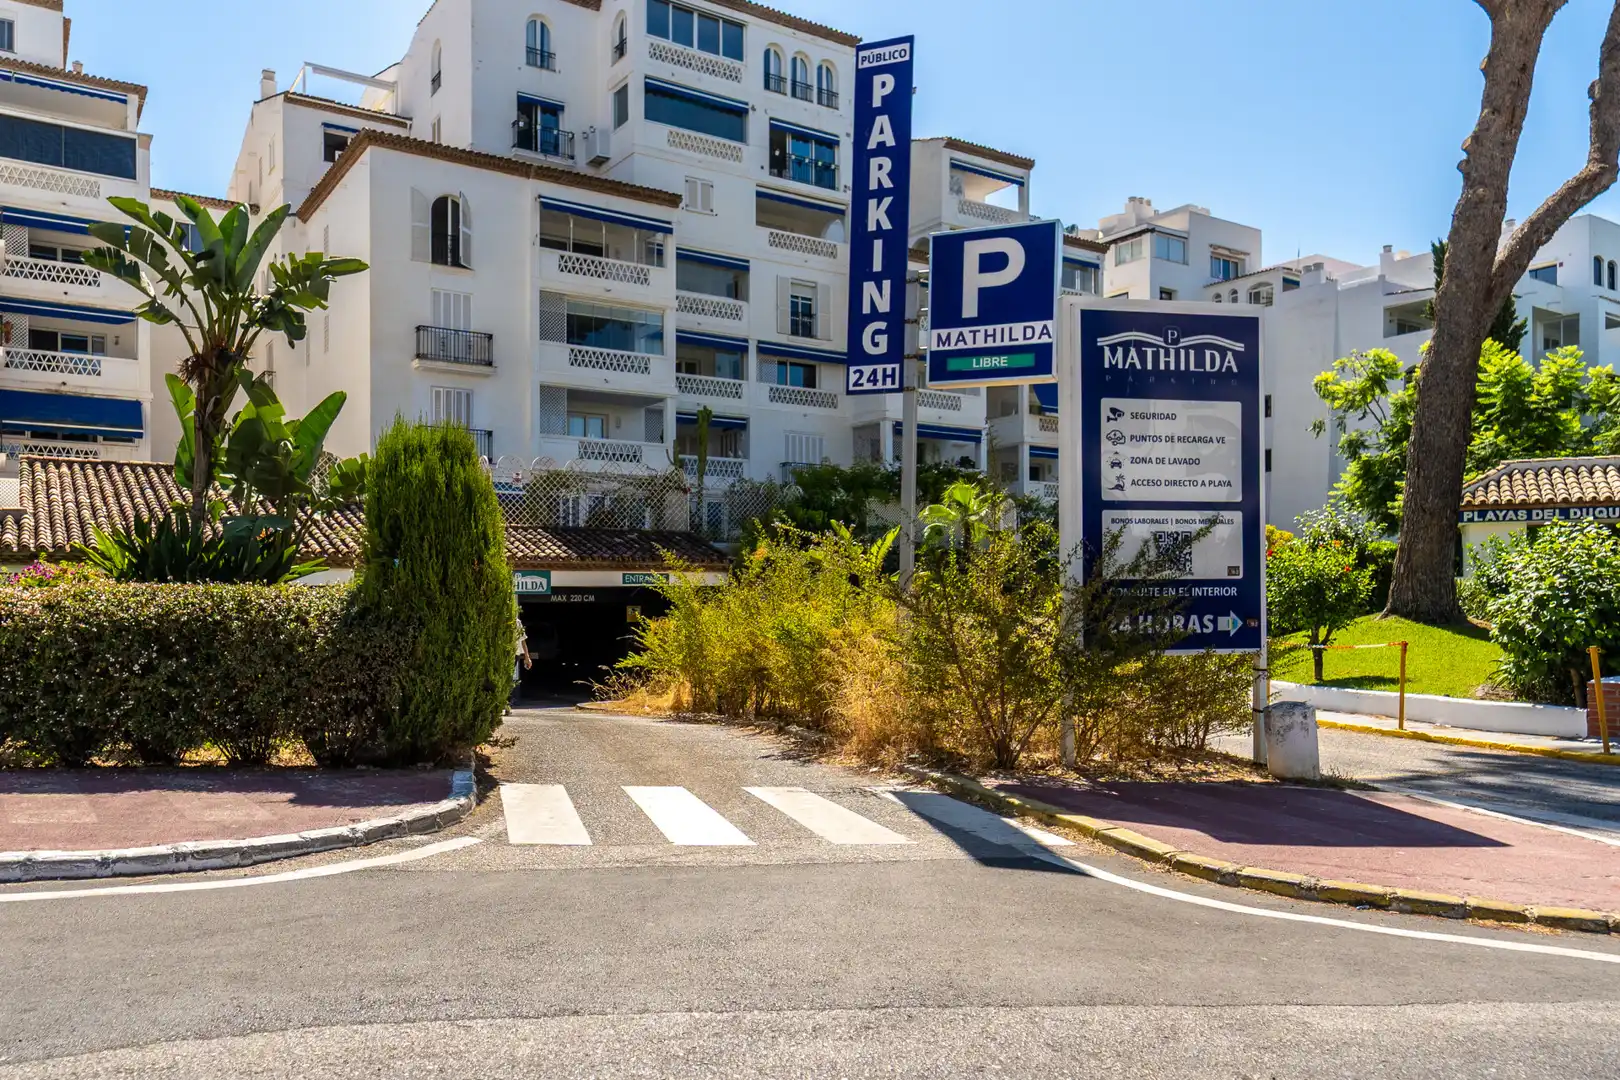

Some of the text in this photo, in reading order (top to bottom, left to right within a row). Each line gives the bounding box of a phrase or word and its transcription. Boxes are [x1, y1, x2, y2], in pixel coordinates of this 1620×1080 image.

[860, 48, 907, 66] PÚBLICO
[862, 73, 896, 355] PARKING
[961, 236, 1026, 319] P
[936, 324, 1053, 348] MATHILDA
[1168, 330, 1178, 343] P
[972, 356, 1008, 368] LIBRE
[1103, 346, 1238, 373] MATHILDA
[852, 367, 896, 388] 24H
[1130, 412, 1177, 420] SEGURIDAD
[1130, 434, 1226, 444] PUNTOS DE RECARGA VE
[1130, 456, 1200, 466] ZONA DE LAVADO
[1131, 479, 1162, 487] ACCESO
[1165, 479, 1198, 487] DIRECTO
[1208, 480, 1233, 488] PLAYA
[1111, 517, 1133, 525] BONOS
[1134, 517, 1169, 525] LABORALES
[1463, 509, 1527, 522] PLAYAS
[1531, 508, 1565, 520] DEL
[551, 594, 595, 602] MAX 220 CM
[1163, 587, 1176, 597] EN
[1192, 587, 1238, 597] INTERIOR
[1138, 614, 1214, 634] HORAS
